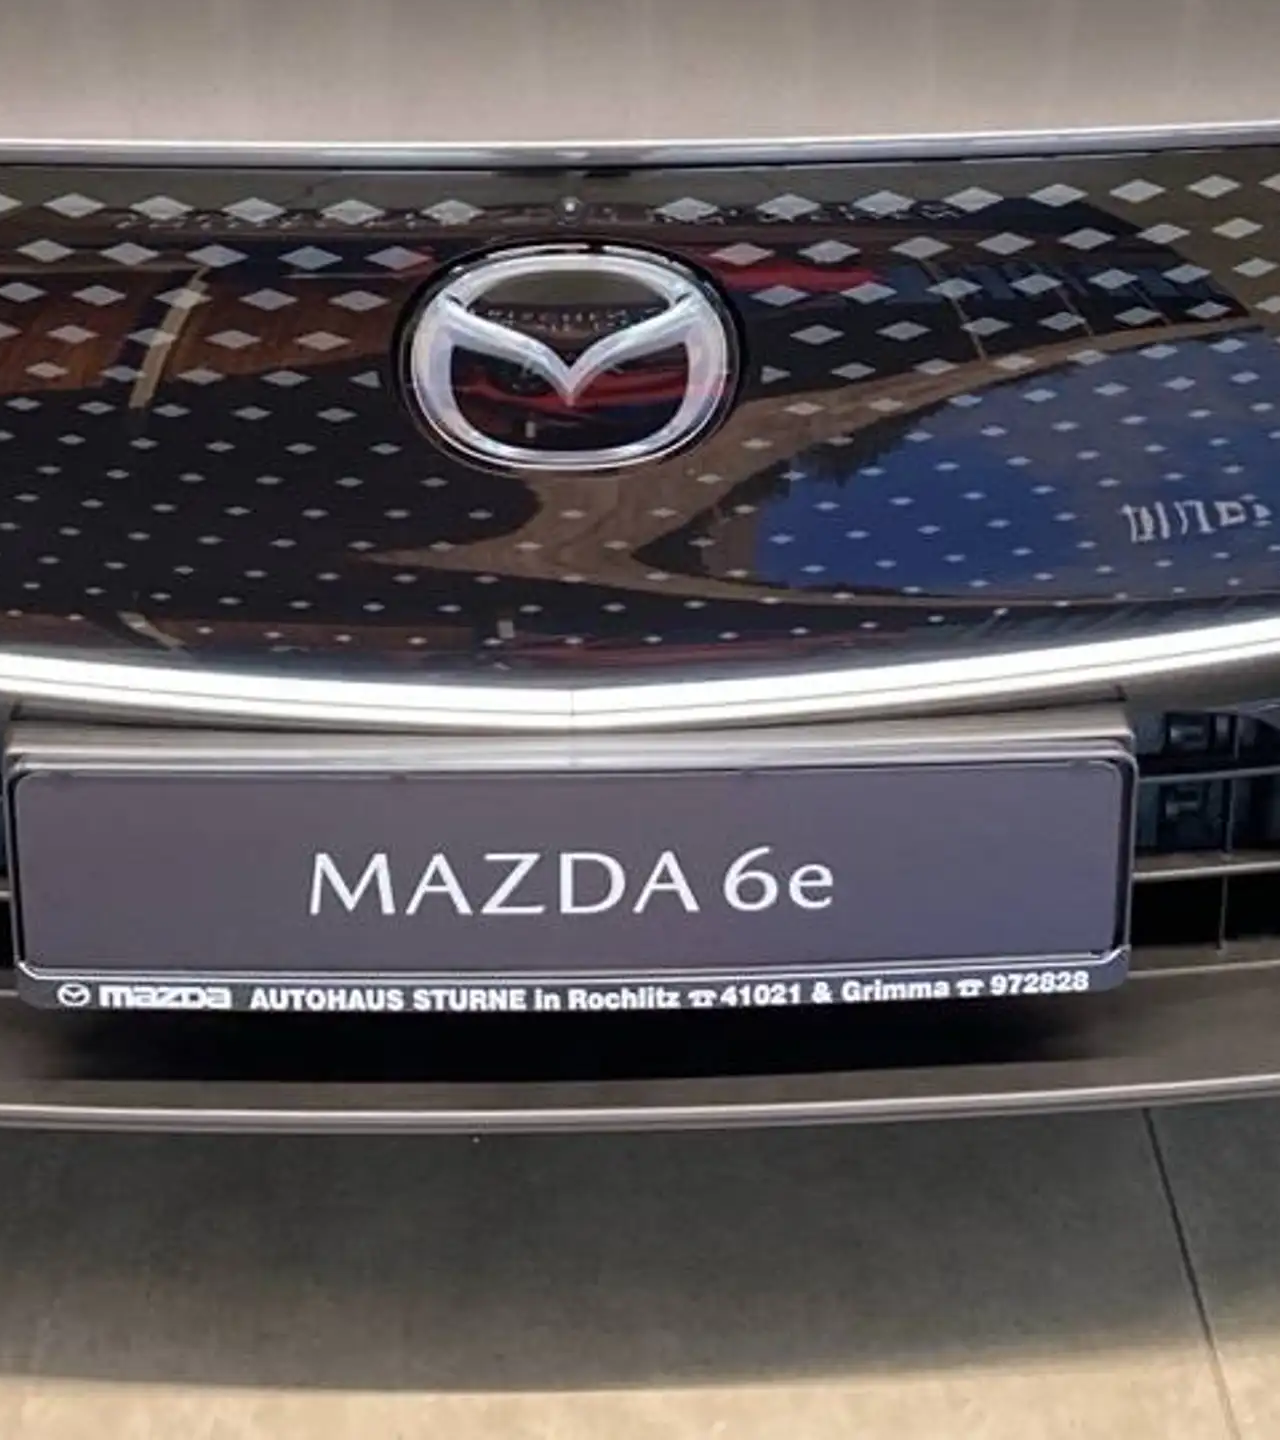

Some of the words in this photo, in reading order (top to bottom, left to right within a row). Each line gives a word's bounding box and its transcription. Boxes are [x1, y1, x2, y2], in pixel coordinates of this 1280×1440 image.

[310, 850, 700, 916] MAZDA
[723, 845, 834, 912] 6e
[98, 984, 233, 1010] mazda
[249, 987, 405, 1011] AUTOHAUS
[412, 988, 527, 1011] STURNE
[535, 986, 561, 1010] in
[568, 985, 681, 1010] Rochlitz
[719, 983, 801, 1007] 41021
[811, 981, 832, 1005] &
[841, 978, 951, 1004] Grimma
[989, 970, 1090, 997] 972828
